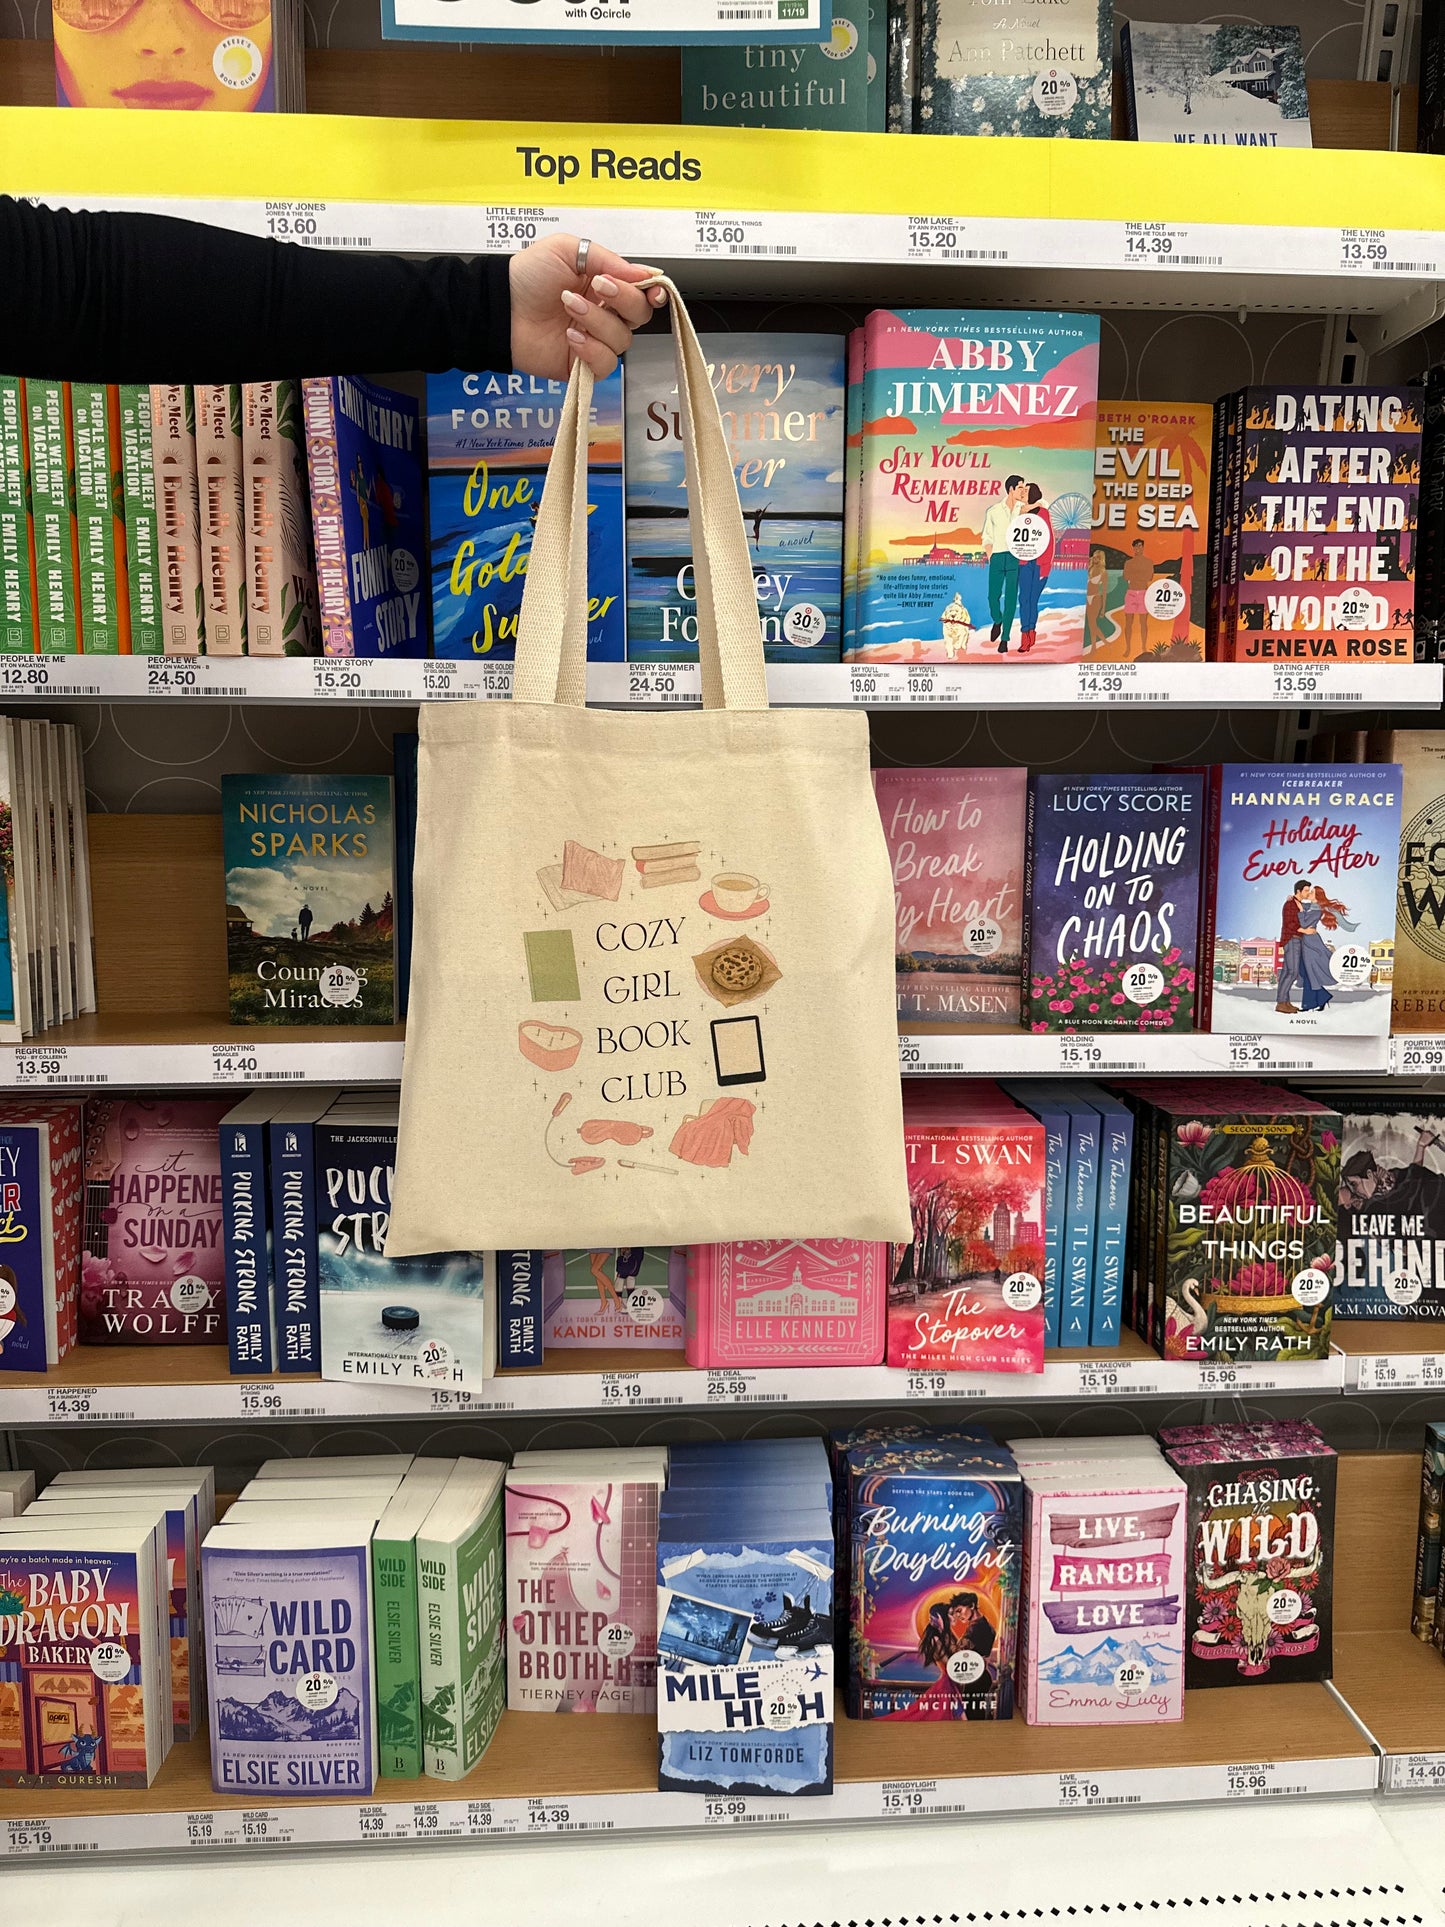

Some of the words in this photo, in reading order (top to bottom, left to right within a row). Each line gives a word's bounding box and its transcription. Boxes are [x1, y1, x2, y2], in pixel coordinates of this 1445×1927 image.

[565, 9, 587, 19] with
[602, 9, 631, 19] circle
[782, 8, 805, 18] 11/19
[744, 45, 806, 73] tiny
[948, 40, 992, 62] Ann
[1001, 38, 1086, 63] Patchett
[702, 79, 848, 111] beautiful
[516, 147, 579, 184] Top
[591, 149, 701, 181] Reads
[265, 203, 293, 211] DAISY
[295, 203, 326, 211] JONES
[518, 208, 544, 216] FIRES
[695, 212, 716, 220] TINY
[267, 218, 317, 235] 13.60
[487, 223, 536, 239] 13.60
[909, 217, 929, 225] TOM
[932, 217, 953, 225] LAKE
[1125, 223, 1141, 231] THE
[1145, 223, 1166, 231] LAST
[696, 227, 744, 243] 13.60
[909, 232, 957, 247] 15.20
[1341, 229, 1358, 237] THE
[1361, 229, 1386, 238] LYING
[1126, 238, 1172, 253] 14.39
[1342, 245, 1387, 259] 13.59
[901, 326, 921, 334] NEW
[924, 326, 950, 335] YORK
[953, 326, 981, 335] TIMES
[984, 327, 1046, 336] BESTSELLING
[1049, 329, 1083, 337] AUTHOR
[928, 339, 1046, 372] ABBY
[886, 382, 1080, 417] JIMENEZ
[31, 406, 42, 421] ON
[45, 390, 60, 437] PEOPLE
[306, 387, 331, 439] FUNNY
[1275, 395, 1402, 433] DATING
[1108, 427, 1144, 443] THE
[33, 426, 50, 494] VACATION
[49, 442, 62, 465] WE
[879, 445, 924, 473] SAY
[930, 446, 991, 469] YOU'LL
[311, 445, 336, 496] STORY
[1278, 447, 1392, 484] AFTER
[49, 472, 64, 507] MEET
[463, 461, 533, 517] One
[891, 472, 1001, 503] REMEMBER
[1103, 483, 1146, 498] THE
[1149, 483, 1193, 498] DEEP
[924, 500, 960, 523] ME
[1137, 505, 1199, 529] SEA
[1260, 496, 1327, 532] THE
[1337, 497, 1405, 532] END
[317, 516, 341, 562] EMILY
[1013, 527, 1030, 542] 20
[1270, 546, 1313, 581] OF
[1323, 546, 1389, 581] THE
[321, 567, 346, 616] HENRY
[1246, 639, 1337, 657] JENEVA
[1346, 639, 1408, 657] ROSE
[1, 655, 31, 663] PEOPLE
[33, 655, 47, 663] WE
[49, 655, 65, 663] ME
[2, 670, 49, 684] 12.80
[148, 671, 195, 685] 24.50
[314, 673, 361, 688] 15.20
[629, 678, 674, 692] 24.50
[1078, 678, 1122, 691] 14.39
[1274, 678, 1317, 691] 13.59
[1053, 794, 1111, 812] LUCY
[1118, 795, 1192, 812] SCORE
[1231, 793, 1320, 806] HANNAH
[1329, 793, 1394, 806] GRACE
[239, 803, 376, 825] NICHOLAS
[890, 798, 949, 838] How
[957, 793, 983, 830] to
[1262, 817, 1361, 849] Holiday
[250, 832, 369, 858] SPARKS
[893, 841, 984, 883] Break
[1055, 826, 1187, 886] HOLDING
[1243, 850, 1303, 881] Ever
[1308, 844, 1379, 880] After
[1084, 882, 1116, 909] ON
[1124, 875, 1154, 905] TO
[596, 917, 686, 952] COZY
[1057, 901, 1175, 964] CHAOS
[603, 970, 681, 1004] GIRL
[596, 1020, 691, 1054] BOOK
[15, 1047, 67, 1055] REGRETTING
[1061, 1048, 1101, 1061] 15.19
[1230, 1048, 1270, 1061] 15.20
[1404, 1052, 1442, 1064] 20.99
[16, 1061, 61, 1075] 13.59
[213, 1058, 257, 1072] 14.40
[601, 1071, 687, 1103] CLUB
[231, 1171, 255, 1242] PUCKING
[1179, 1205, 1330, 1225] BEAUTIFUL
[1202, 1240, 1304, 1260] THINGS
[235, 1248, 258, 1314] STRONG
[942, 1286, 987, 1322] The
[102, 1314, 220, 1334] WOLFF
[553, 1326, 606, 1339] KANDI
[614, 1326, 682, 1338] STEINER
[735, 1321, 772, 1339] ELLE
[781, 1321, 857, 1339] KENNEDY
[908, 1312, 1025, 1353] Stopover
[237, 1325, 249, 1361] RATH
[250, 1324, 262, 1363] EMILY
[1185, 1337, 1248, 1351] EMILY
[1255, 1336, 1311, 1350] RATH
[907, 1377, 945, 1389] 15.19
[1080, 1374, 1118, 1385] 15.19
[1200, 1371, 1236, 1382] 15.96
[431, 1391, 471, 1403] 15.19
[602, 1385, 641, 1398] 15.19
[707, 1382, 747, 1395] 25.59
[49, 1400, 90, 1412] 14.39
[241, 1396, 282, 1408] 15.96
[1206, 1477, 1313, 1508] CHASING
[859, 1504, 995, 1542] Burning
[1078, 1516, 1146, 1541] LIVE,
[1198, 1511, 1319, 1565] WILD
[863, 1540, 1015, 1583] Daylight
[1060, 1563, 1162, 1587] RANCH,
[28, 1568, 112, 1608] BABY
[270, 1599, 352, 1636] WILD
[1076, 1603, 1145, 1626] LOVE
[269, 1638, 356, 1675] CARD
[520, 1689, 585, 1700] TIERNEY
[591, 1689, 631, 1701] PAGE
[665, 1672, 761, 1702] MILE
[689, 1745, 713, 1762] LIZ
[720, 1746, 805, 1763] TOMFORDE
[18, 1776, 32, 1784] A.
[39, 1776, 50, 1784] T.
[58, 1775, 118, 1785] QURESHI
[222, 1760, 280, 1785] ELSIE
[287, 1760, 360, 1786] SILVER
[1227, 1776, 1266, 1790] 15.96
[882, 1793, 922, 1807] 15.19
[1060, 1784, 1099, 1798] 15.19
[528, 1810, 570, 1822] 14.39
[705, 1802, 746, 1816] 15.99
[8, 1832, 52, 1845] 15.19
